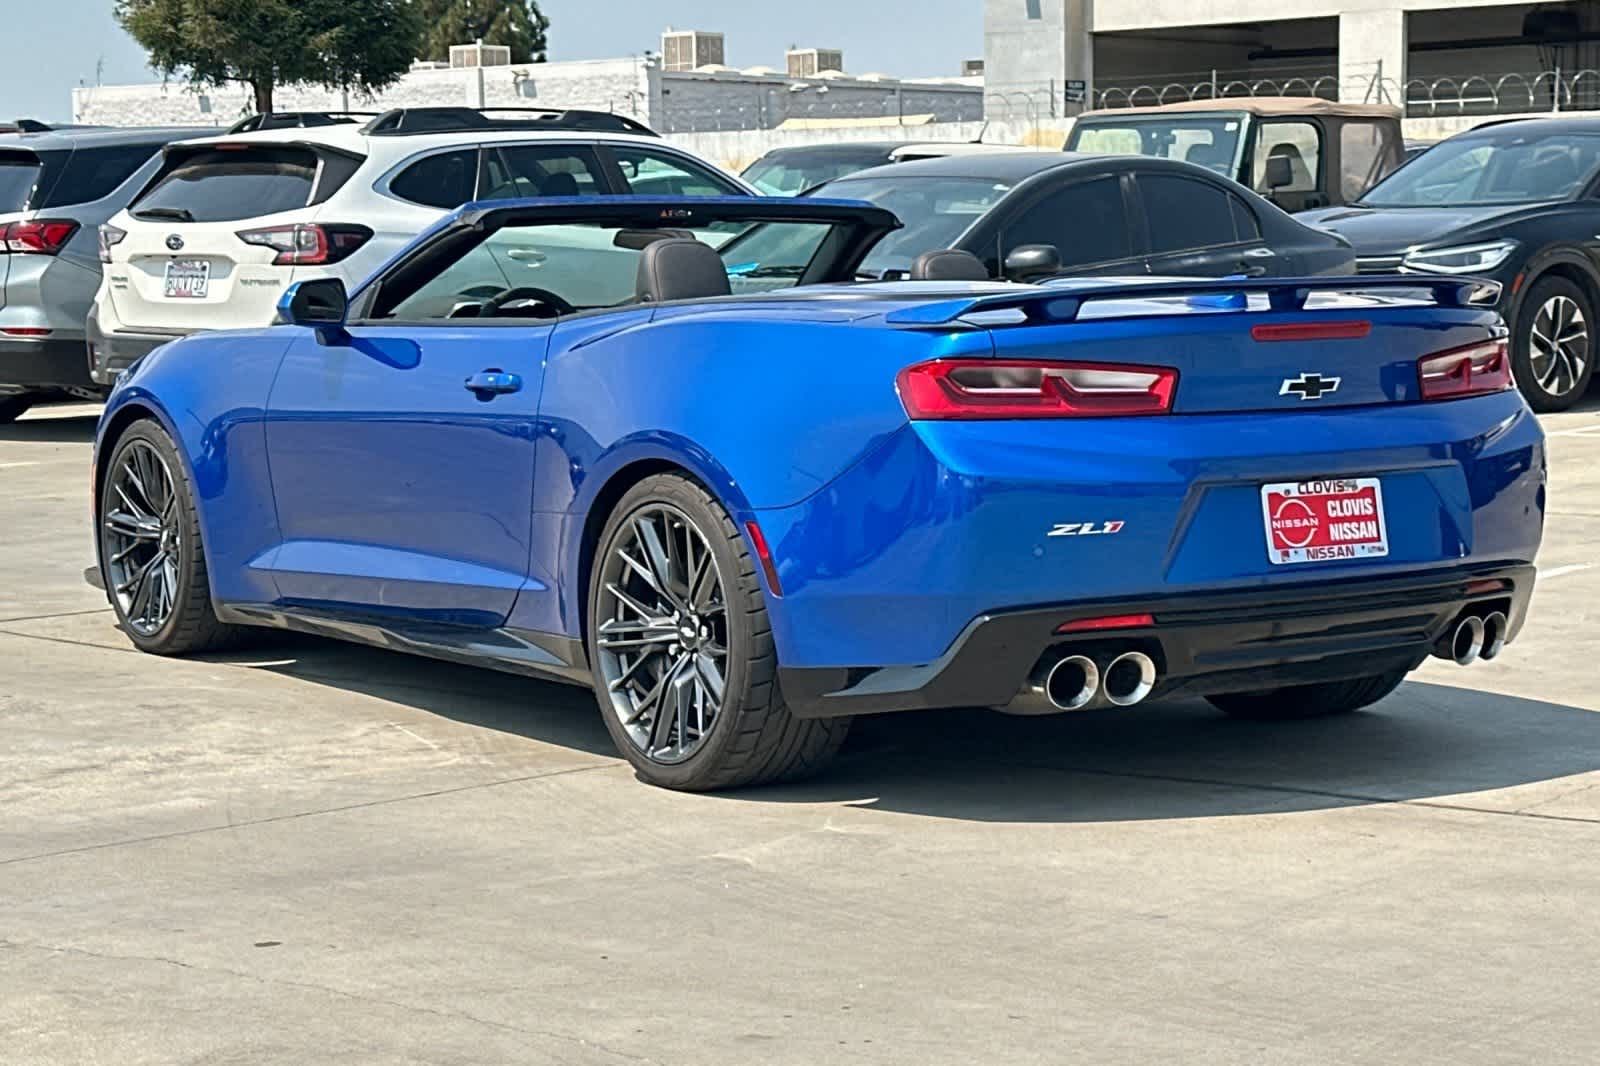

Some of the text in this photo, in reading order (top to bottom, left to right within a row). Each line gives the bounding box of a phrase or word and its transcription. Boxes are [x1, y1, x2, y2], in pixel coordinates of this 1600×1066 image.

[1298, 480, 1345, 494] CLOVIS
[1327, 498, 1374, 517] CLOVIS
[1047, 521, 1125, 536] ZL1
[1272, 518, 1319, 529] NISSAN
[1329, 520, 1378, 541] NISSAN
[1306, 545, 1355, 560] NISSAN
